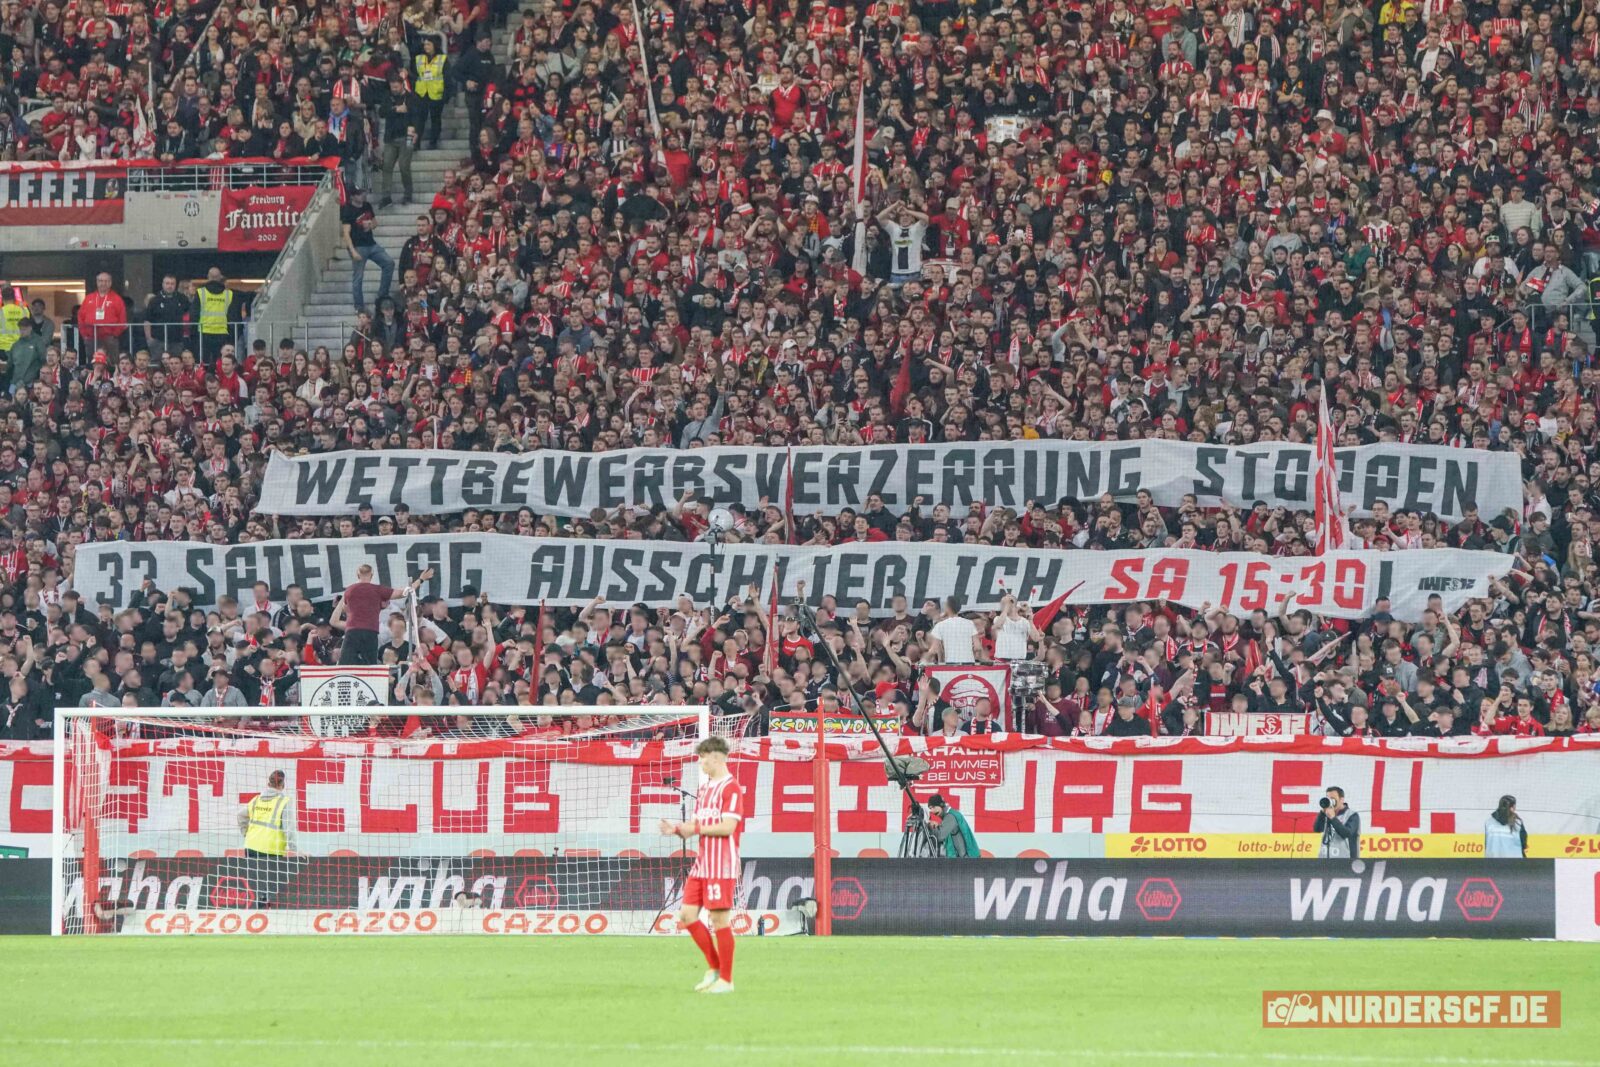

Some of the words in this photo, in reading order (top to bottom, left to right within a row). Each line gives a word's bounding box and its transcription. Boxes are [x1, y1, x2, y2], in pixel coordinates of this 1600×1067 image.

[248, 195, 285, 206] Freiburg
[257, 234, 278, 242] 2002
[296, 447, 1141, 507] WETTBEWERBSVERZERRUNG
[1103, 557, 1190, 600] SA
[950, 759, 998, 769] IMMER
[927, 772, 950, 780] BEI
[954, 771, 986, 781] UNS
[1153, 837, 1208, 852] LOTTO
[1237, 840, 1313, 853] lotto-bw.de
[1368, 837, 1424, 852] LOTTO
[357, 859, 507, 911] wiha
[974, 860, 1128, 922] wiha
[1290, 860, 1448, 922] wiha
[144, 913, 269, 934] CAZOO
[313, 911, 438, 933] CAZOO
[482, 912, 608, 934] CAZOO
